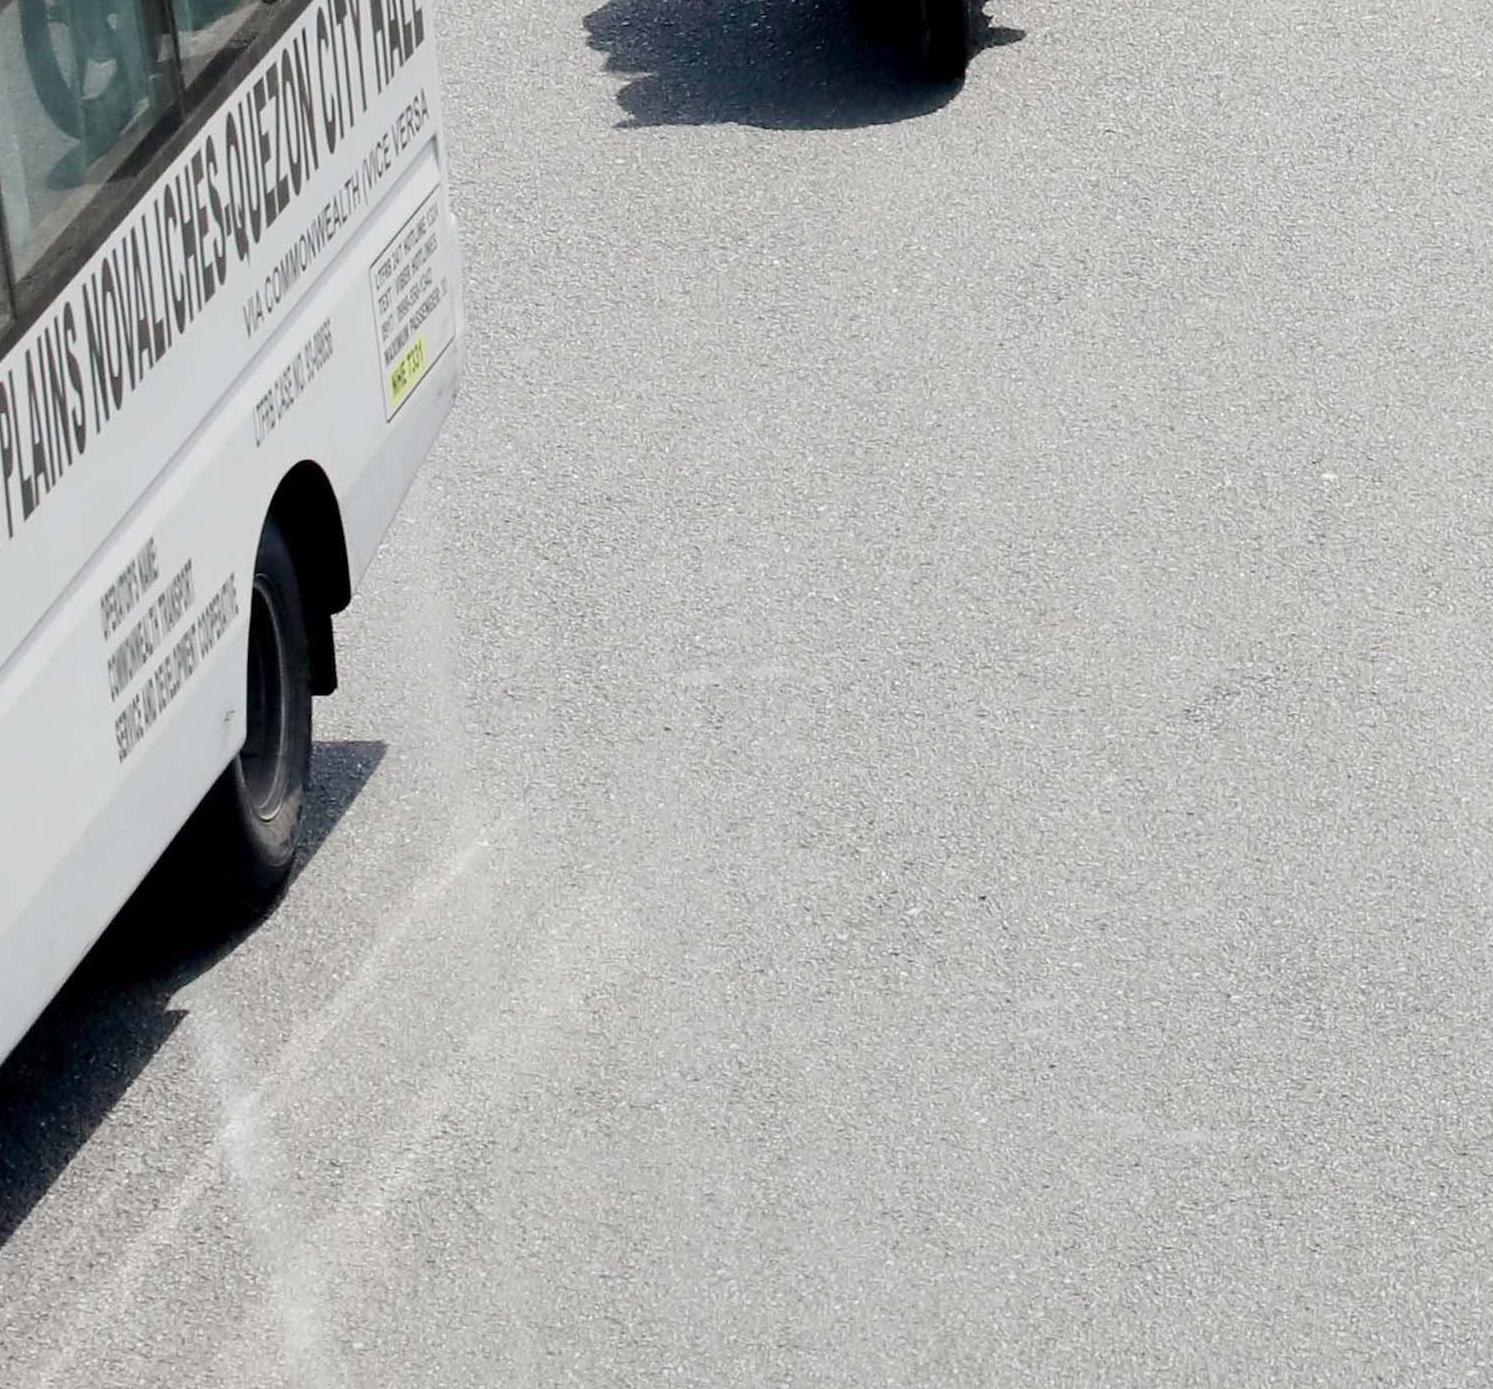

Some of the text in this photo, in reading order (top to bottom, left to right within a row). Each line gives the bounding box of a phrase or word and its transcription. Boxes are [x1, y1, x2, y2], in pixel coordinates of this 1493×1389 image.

[242, 288, 265, 338] VIA
[264, 170, 362, 315] COMMONWEALTH
[391, 87, 429, 157] VERSA
